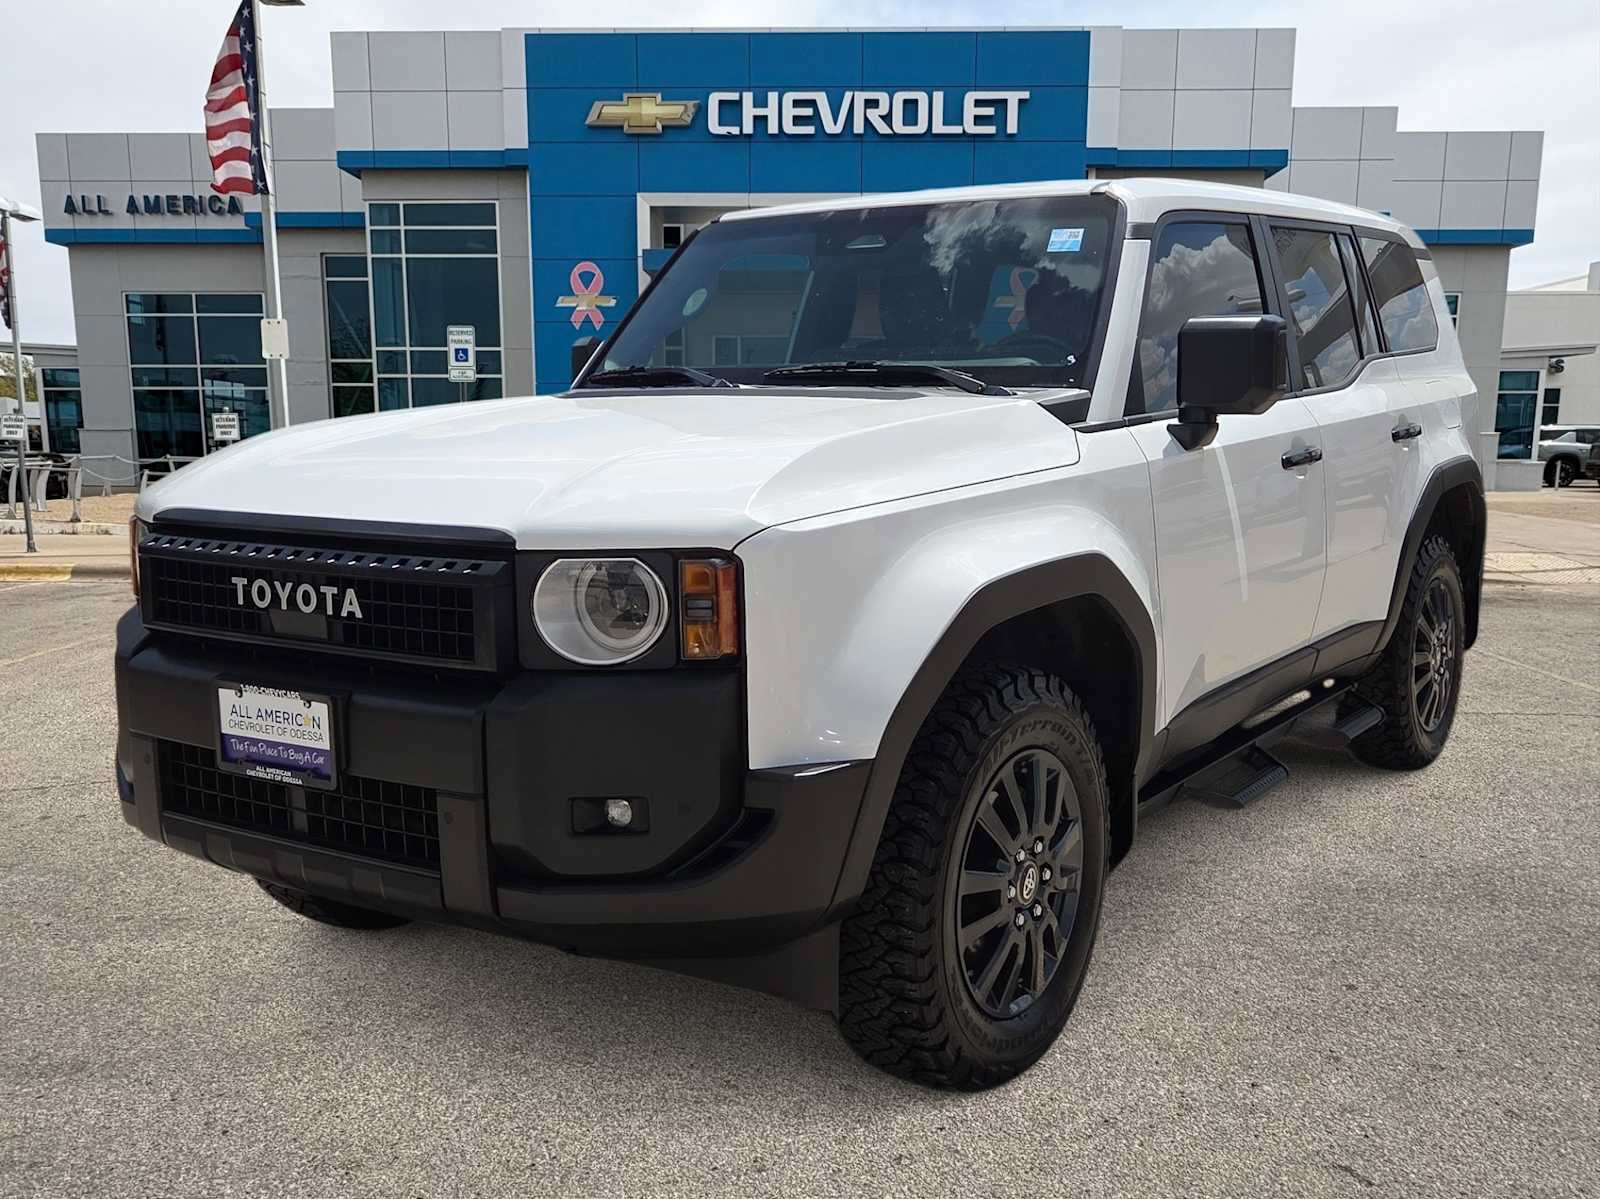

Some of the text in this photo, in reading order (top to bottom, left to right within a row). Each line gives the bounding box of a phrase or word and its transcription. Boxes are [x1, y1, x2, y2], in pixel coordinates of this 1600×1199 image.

[707, 91, 1031, 135] CHEVROLET
[64, 194, 112, 216] ALL
[231, 576, 363, 619] TOYOTA
[230, 704, 321, 730] ALL AMERICN
[228, 719, 324, 742] CHEVROLET OF ODESSA
[230, 739, 325, 765] The Fun Place To Buy A Car
